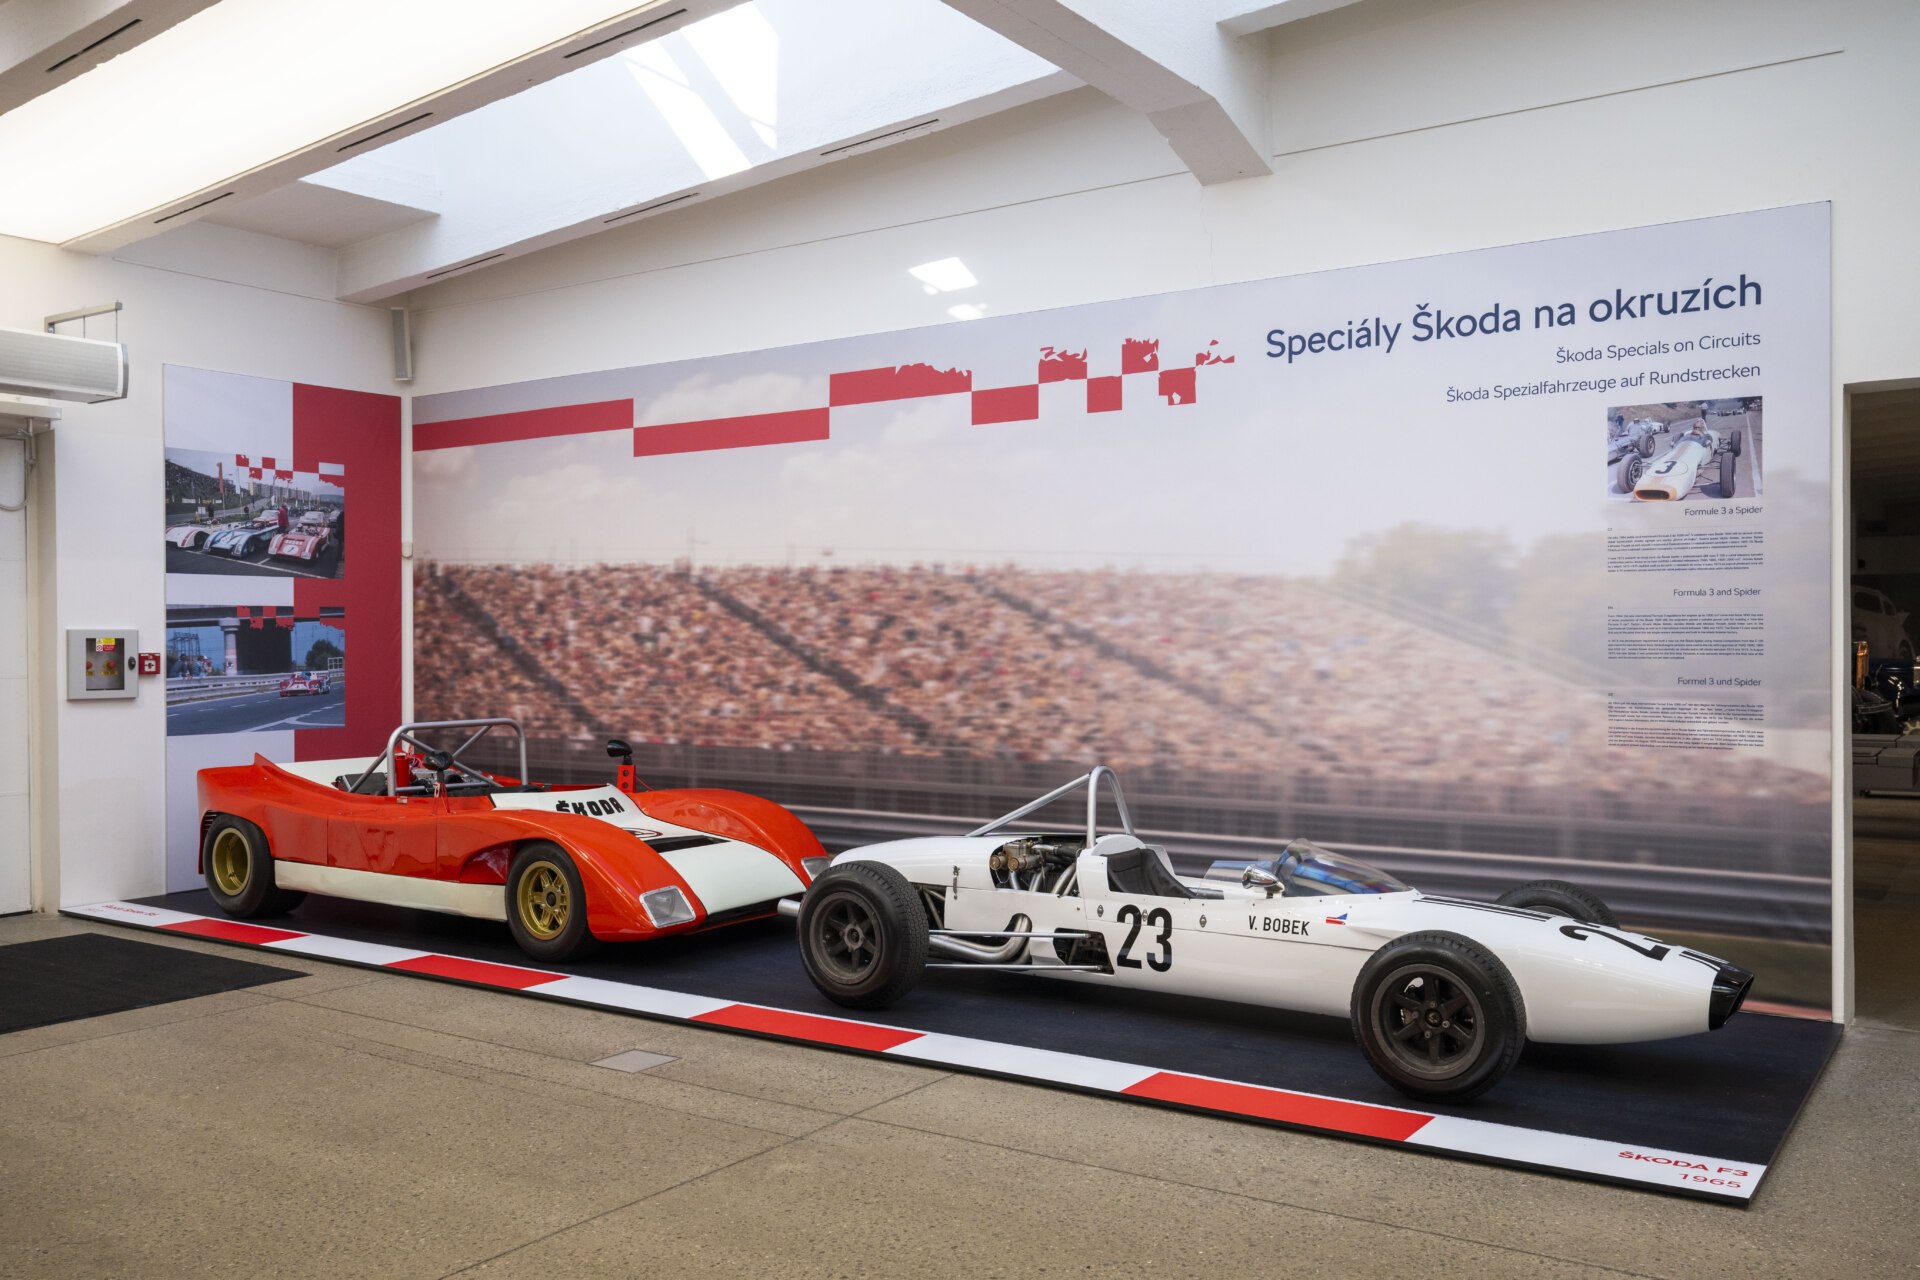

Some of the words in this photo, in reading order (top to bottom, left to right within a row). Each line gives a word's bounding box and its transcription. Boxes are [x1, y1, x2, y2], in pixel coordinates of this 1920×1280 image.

[1266, 316, 1402, 364] Speciály
[1411, 302, 1521, 342] Škoda
[1534, 302, 1576, 329] na
[1588, 273, 1762, 323] okruzích
[1556, 346, 1603, 364] Škoda
[1607, 340, 1670, 361] Specials
[1673, 340, 1694, 353] on
[1698, 332, 1761, 350] Circuits
[1446, 386, 1490, 403] Škoda
[1493, 377, 1617, 401] Spezialfahrzeuge
[1620, 372, 1645, 388] auf
[1649, 364, 1761, 385] Rundstrecken
[1655, 461, 1677, 474] 3
[1684, 507, 1719, 517] Formule
[1720, 506, 1727, 515] 3
[1735, 505, 1763, 516] Spider
[1673, 588, 1707, 597] Formula
[1708, 588, 1715, 597] 3
[1716, 587, 1732, 597] and
[1733, 587, 1761, 598] Spider
[1677, 676, 1707, 686] Formel
[1708, 677, 1715, 686] 3
[1716, 677, 1733, 686] und
[1734, 677, 1762, 688] Spider
[555, 796, 626, 817] ŠKODA
[1248, 915, 1258, 931] V.
[1262, 917, 1311, 937] BOBEK
[1116, 904, 1173, 973] 23
[1617, 1150, 1709, 1172] ŠKODA
[1716, 1166, 1750, 1178] F3
[1679, 1173, 1742, 1189] 1965
